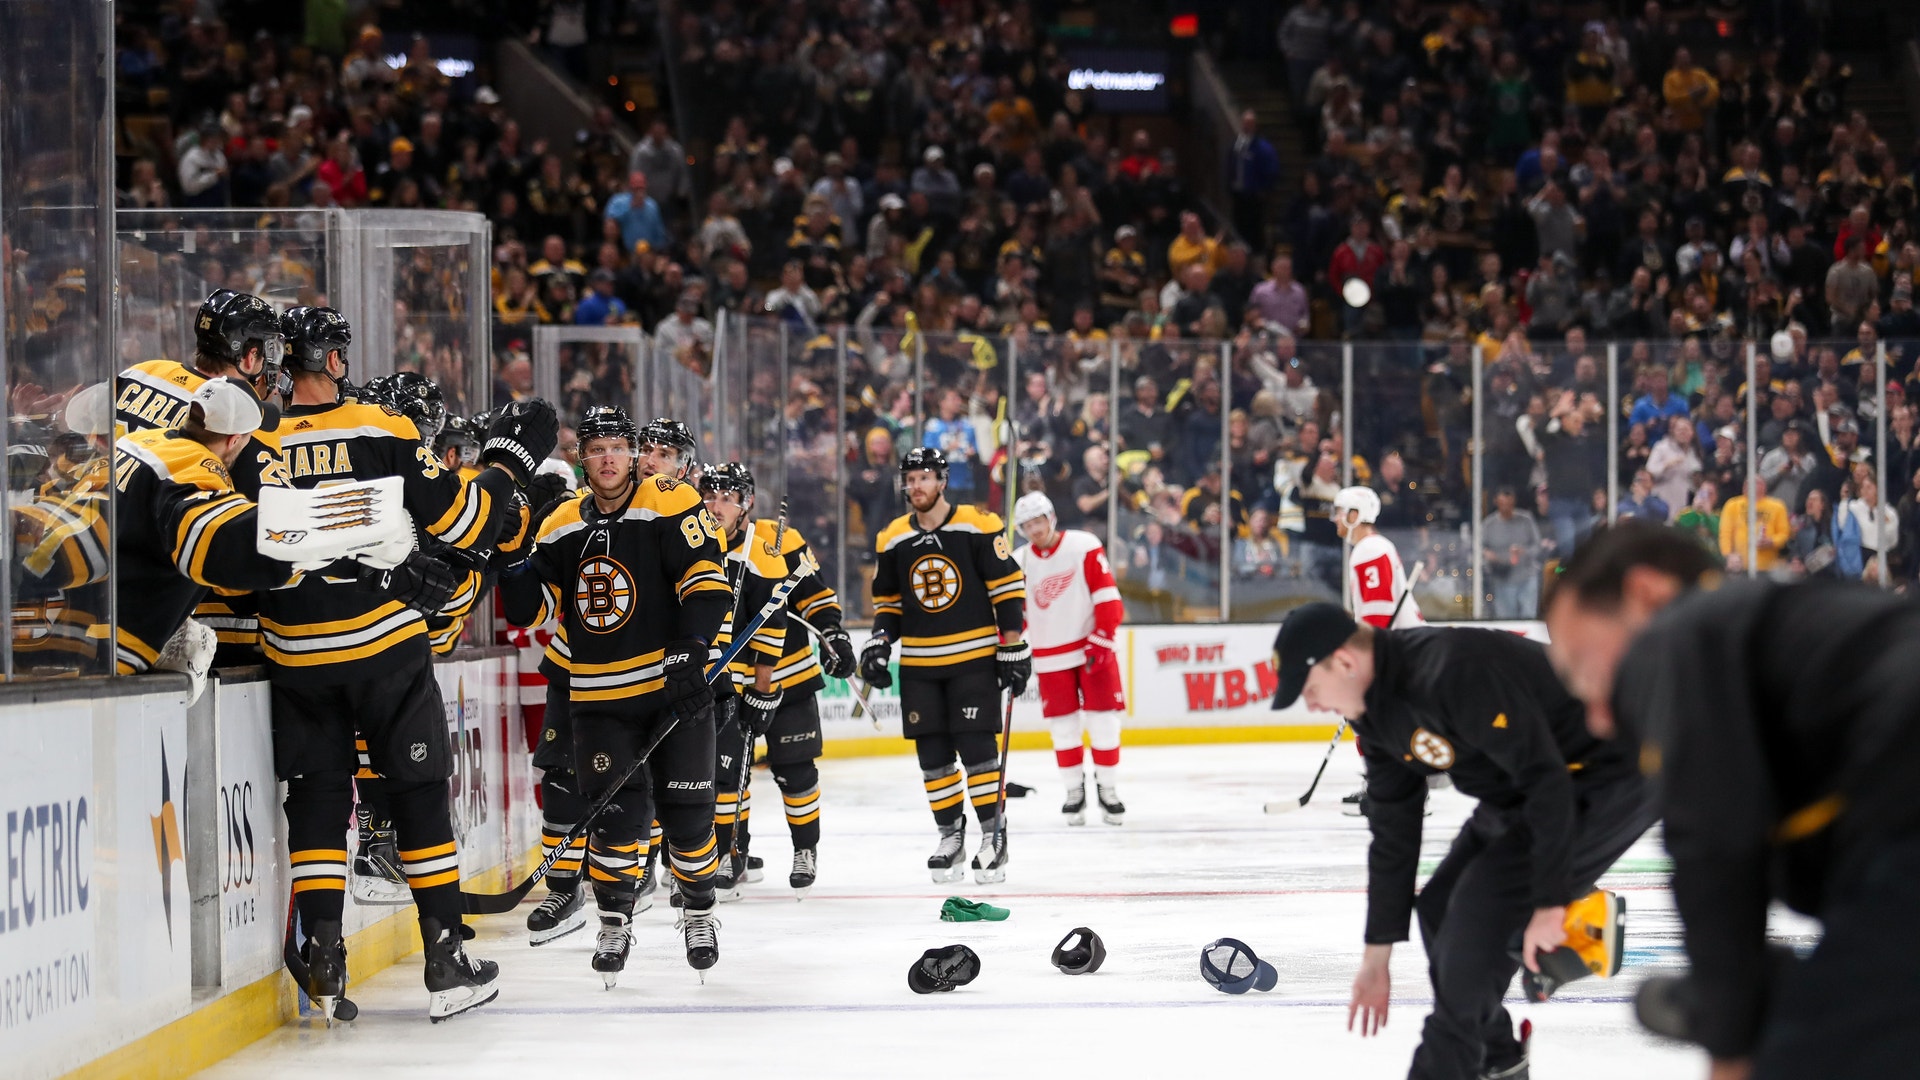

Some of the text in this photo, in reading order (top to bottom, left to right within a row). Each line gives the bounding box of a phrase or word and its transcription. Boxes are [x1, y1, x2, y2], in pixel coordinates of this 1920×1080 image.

[483, 437, 536, 472] WARRIO
[680, 508, 720, 549] 88
[1364, 566, 1380, 589] 3
[586, 573, 616, 617] B
[663, 653, 690, 667] UER
[1156, 643, 1224, 664] WHO BUT
[780, 731, 816, 744] CCM
[666, 780, 712, 791] BAUER
[532, 836, 571, 884] BAUER
[0, 950, 90, 1030] RPORATION
